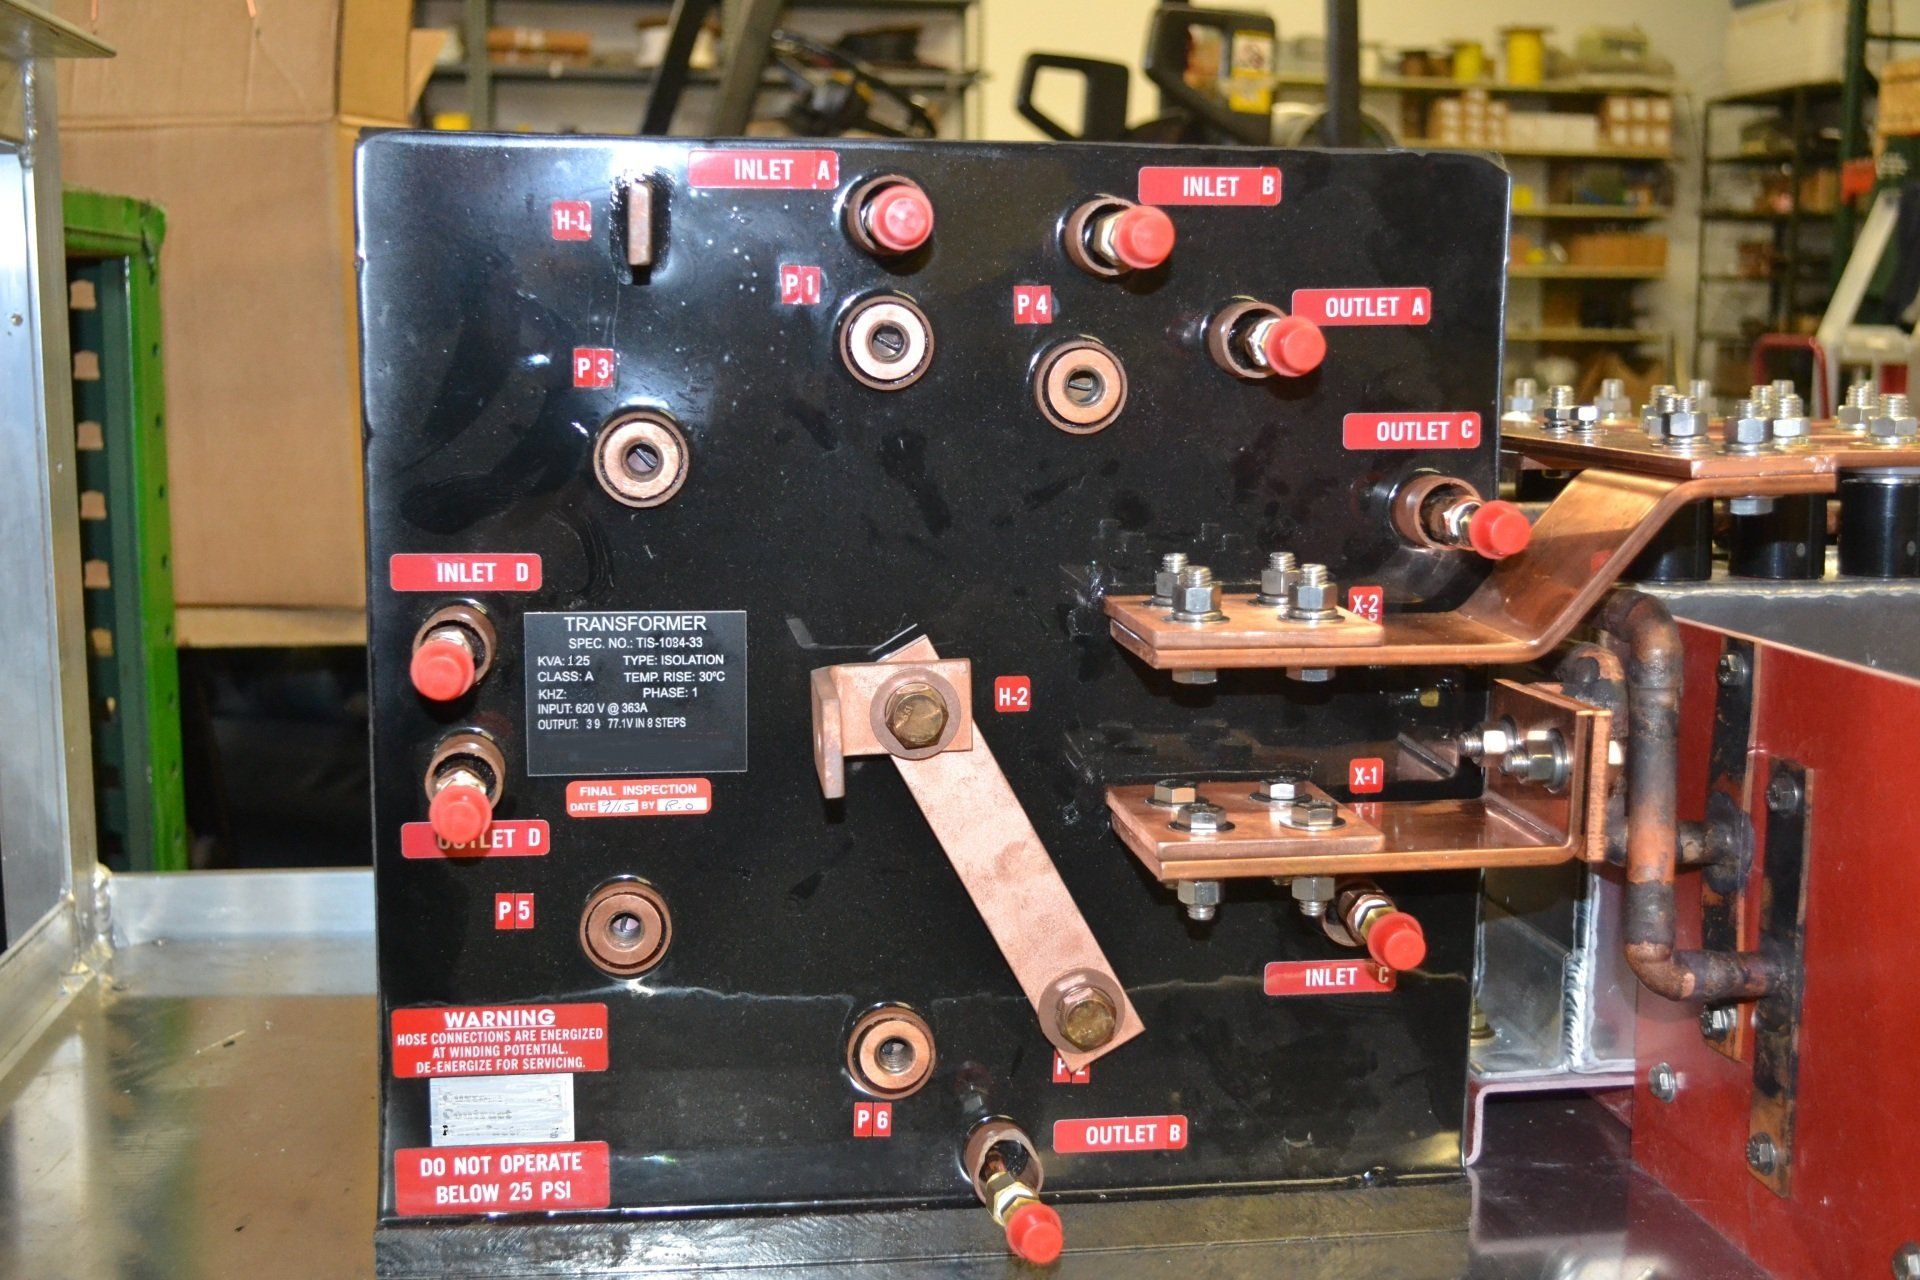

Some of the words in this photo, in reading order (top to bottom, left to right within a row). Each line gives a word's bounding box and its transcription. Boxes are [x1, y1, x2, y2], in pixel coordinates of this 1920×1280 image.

[734, 160, 793, 179] INLET
[818, 160, 830, 179] A
[1183, 176, 1239, 197] INLET
[1262, 175, 1274, 195] B
[557, 209, 587, 231] H-1
[1325, 297, 1399, 317] OUTLET
[1412, 297, 1424, 316] A
[1376, 421, 1449, 441] OUTLET
[1461, 419, 1472, 438] C
[437, 562, 497, 583] INLET
[516, 562, 529, 582] D
[1352, 594, 1379, 614] X-2
[563, 615, 707, 632] TRANSFORMER
[568, 637, 606, 649] SPEC.
[608, 637, 633, 649] NO.:
[537, 655, 566, 667] KVA:
[567, 654, 591, 667] 125
[623, 655, 658, 666] TYPE:
[661, 654, 724, 666] ISOLATION
[537, 670, 582, 682] CLASS:
[584, 670, 595, 681] A
[624, 671, 660, 683] TEMP.
[663, 671, 695, 682] RISE:
[538, 689, 567, 700] KHZ:
[643, 687, 689, 698] PHASE:
[692, 686, 698, 698] 1
[999, 687, 1028, 707] H-2
[537, 703, 573, 715] INPUT:
[575, 702, 595, 714] 620
[596, 702, 606, 714] V
[607, 702, 620, 716] @
[621, 702, 648, 713] 363A
[537, 718, 579, 730] OUTPUT:
[635, 717, 645, 728] IN
[647, 717, 653, 728] 8
[655, 716, 687, 728] STEPS
[1353, 766, 1378, 786] X-1
[580, 785, 616, 797] FINAL
[622, 783, 697, 796] INSPECTION
[570, 802, 597, 812] DATE
[641, 800, 655, 810] BY
[528, 827, 541, 847] D
[1305, 967, 1358, 987] INLET
[1378, 966, 1389, 984] C
[444, 1009, 556, 1027] WARNING
[397, 1033, 427, 1045] HOSE
[431, 1031, 511, 1044] CONNECTIONS
[514, 1029, 537, 1042] ARE
[540, 1027, 604, 1041] ENERGIZED
[433, 1047, 446, 1059] AT
[450, 1045, 500, 1058] WINDING
[504, 1043, 569, 1056] POTENTIAL.
[416, 1060, 492, 1073] DE-ENERGIZE
[496, 1058, 519, 1071] FOR
[523, 1056, 586, 1069] SERVICING.
[1086, 1124, 1157, 1145] OUTLET
[1169, 1124, 1181, 1142] B
[420, 1158, 446, 1176] DO
[454, 1156, 492, 1175] NOT
[500, 1152, 583, 1173] OPERATE
[436, 1184, 499, 1203] BELOW
[509, 1183, 533, 1201] 25
[541, 1181, 571, 1200] PSI
